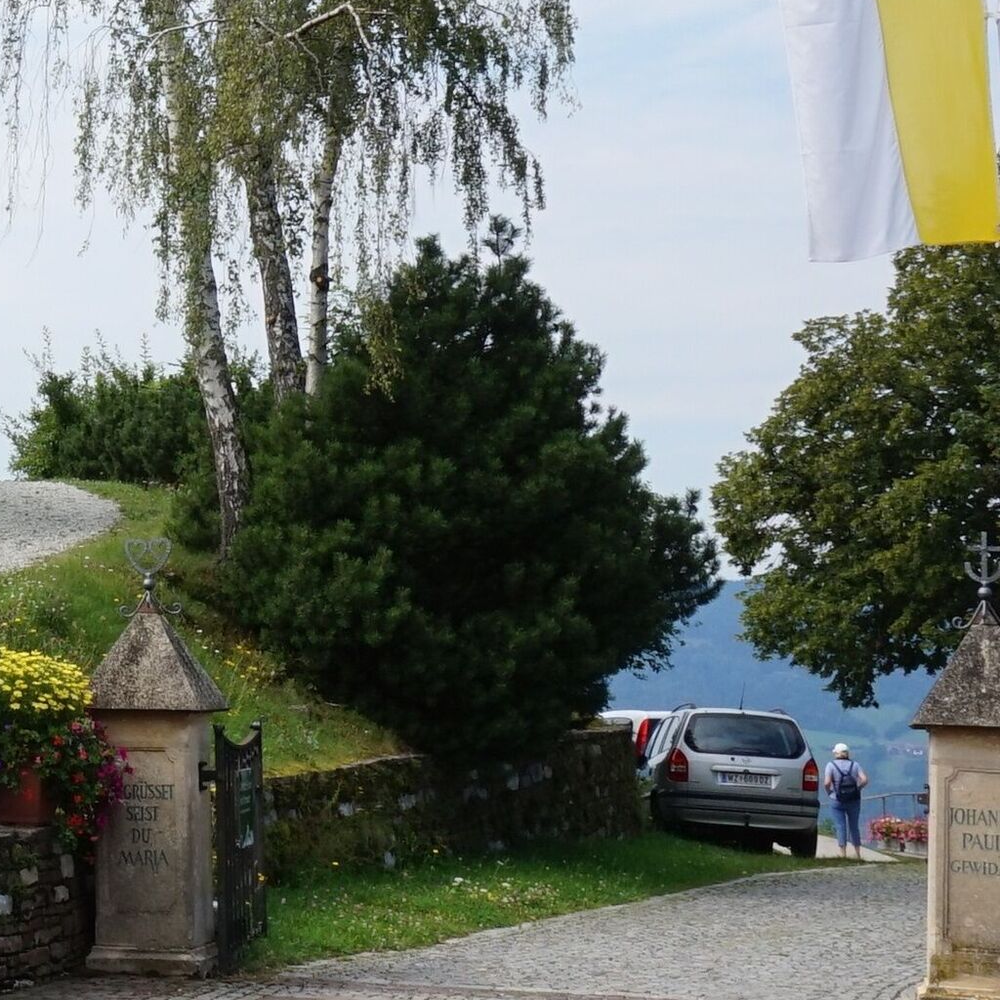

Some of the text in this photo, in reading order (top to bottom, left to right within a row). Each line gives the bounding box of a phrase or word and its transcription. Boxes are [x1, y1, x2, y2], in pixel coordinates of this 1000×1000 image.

[126, 806, 160, 821] SEIST
[132, 828, 153, 843] DU
[950, 860, 1000, 876] GEWID
